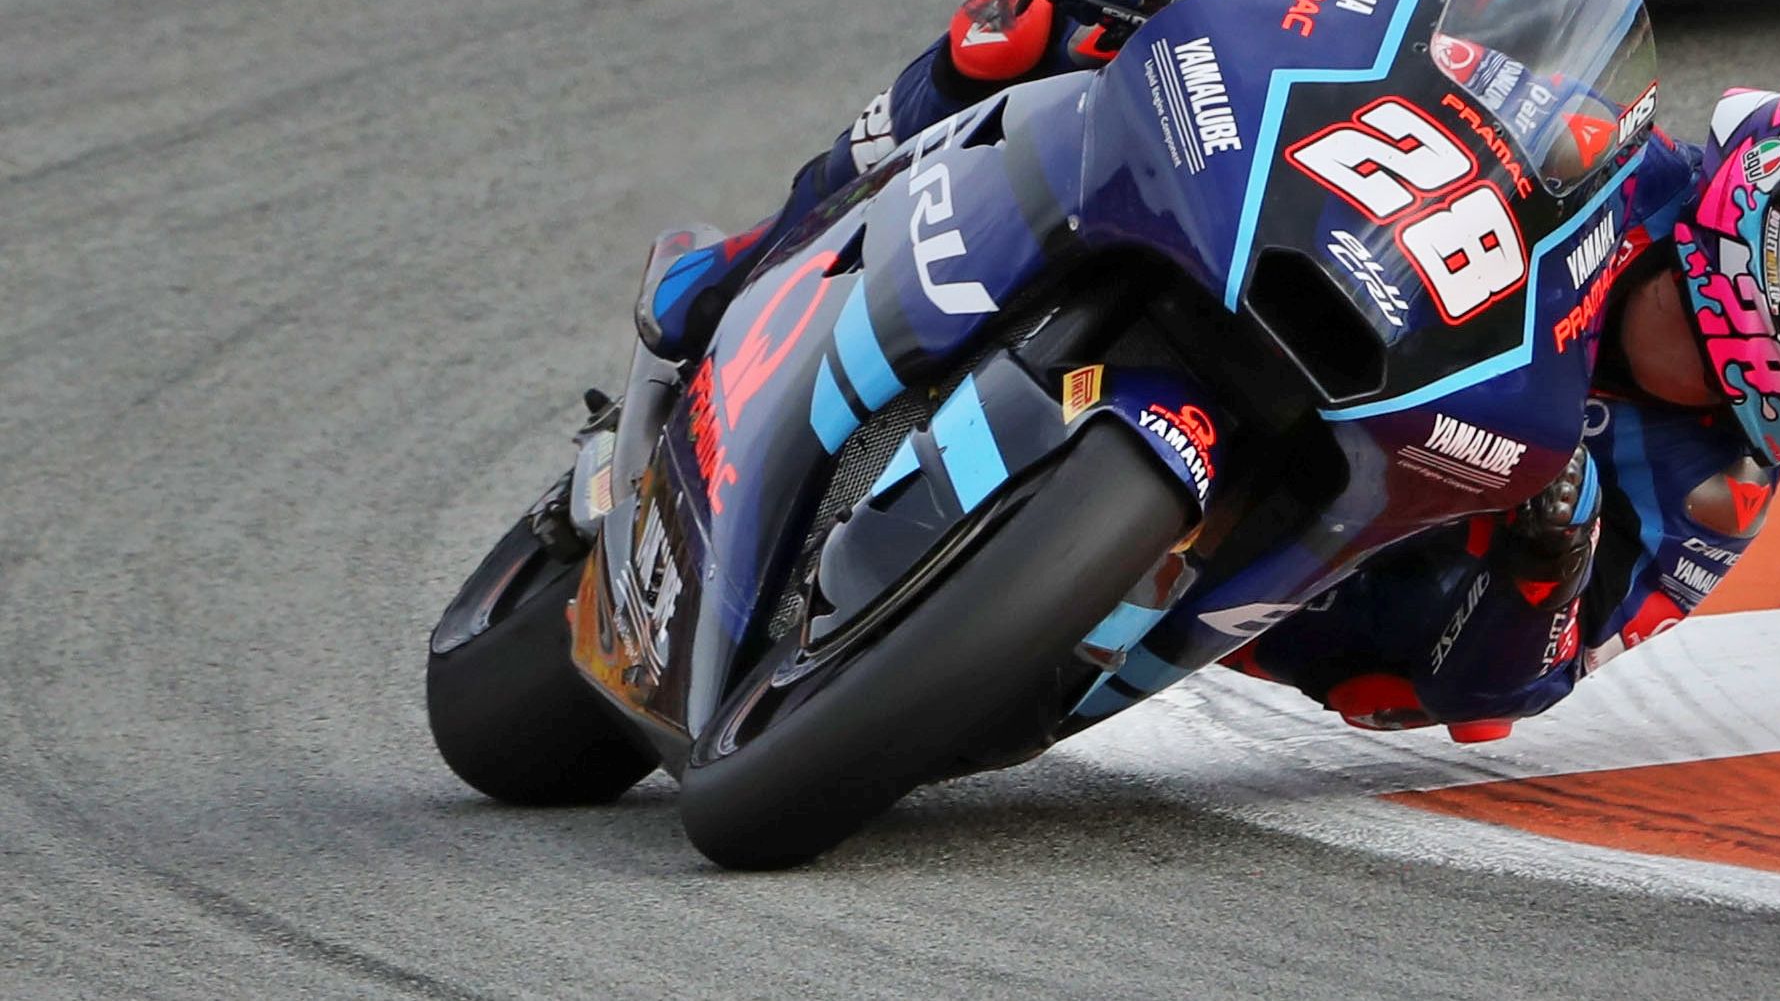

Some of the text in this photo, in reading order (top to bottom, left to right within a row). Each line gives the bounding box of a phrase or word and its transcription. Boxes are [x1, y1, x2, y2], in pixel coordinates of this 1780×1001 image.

[1152, 86, 1165, 116] Engine
[1160, 116, 1182, 169] Component
[1174, 37, 1243, 156] YAMALUBE
[1618, 86, 1656, 146] WRS
[1441, 94, 1533, 199] PRAMAC
[1743, 149, 1763, 179] agv
[1286, 97, 1528, 323] 28
[1566, 210, 1615, 290] YAMAHA
[1553, 256, 1616, 354] PRAMAC
[1071, 367, 1095, 412] PIRELLI
[688, 357, 738, 516] PRAMAC
[1138, 410, 1210, 500] YAMAHA
[1424, 413, 1527, 476] YAMALUBE
